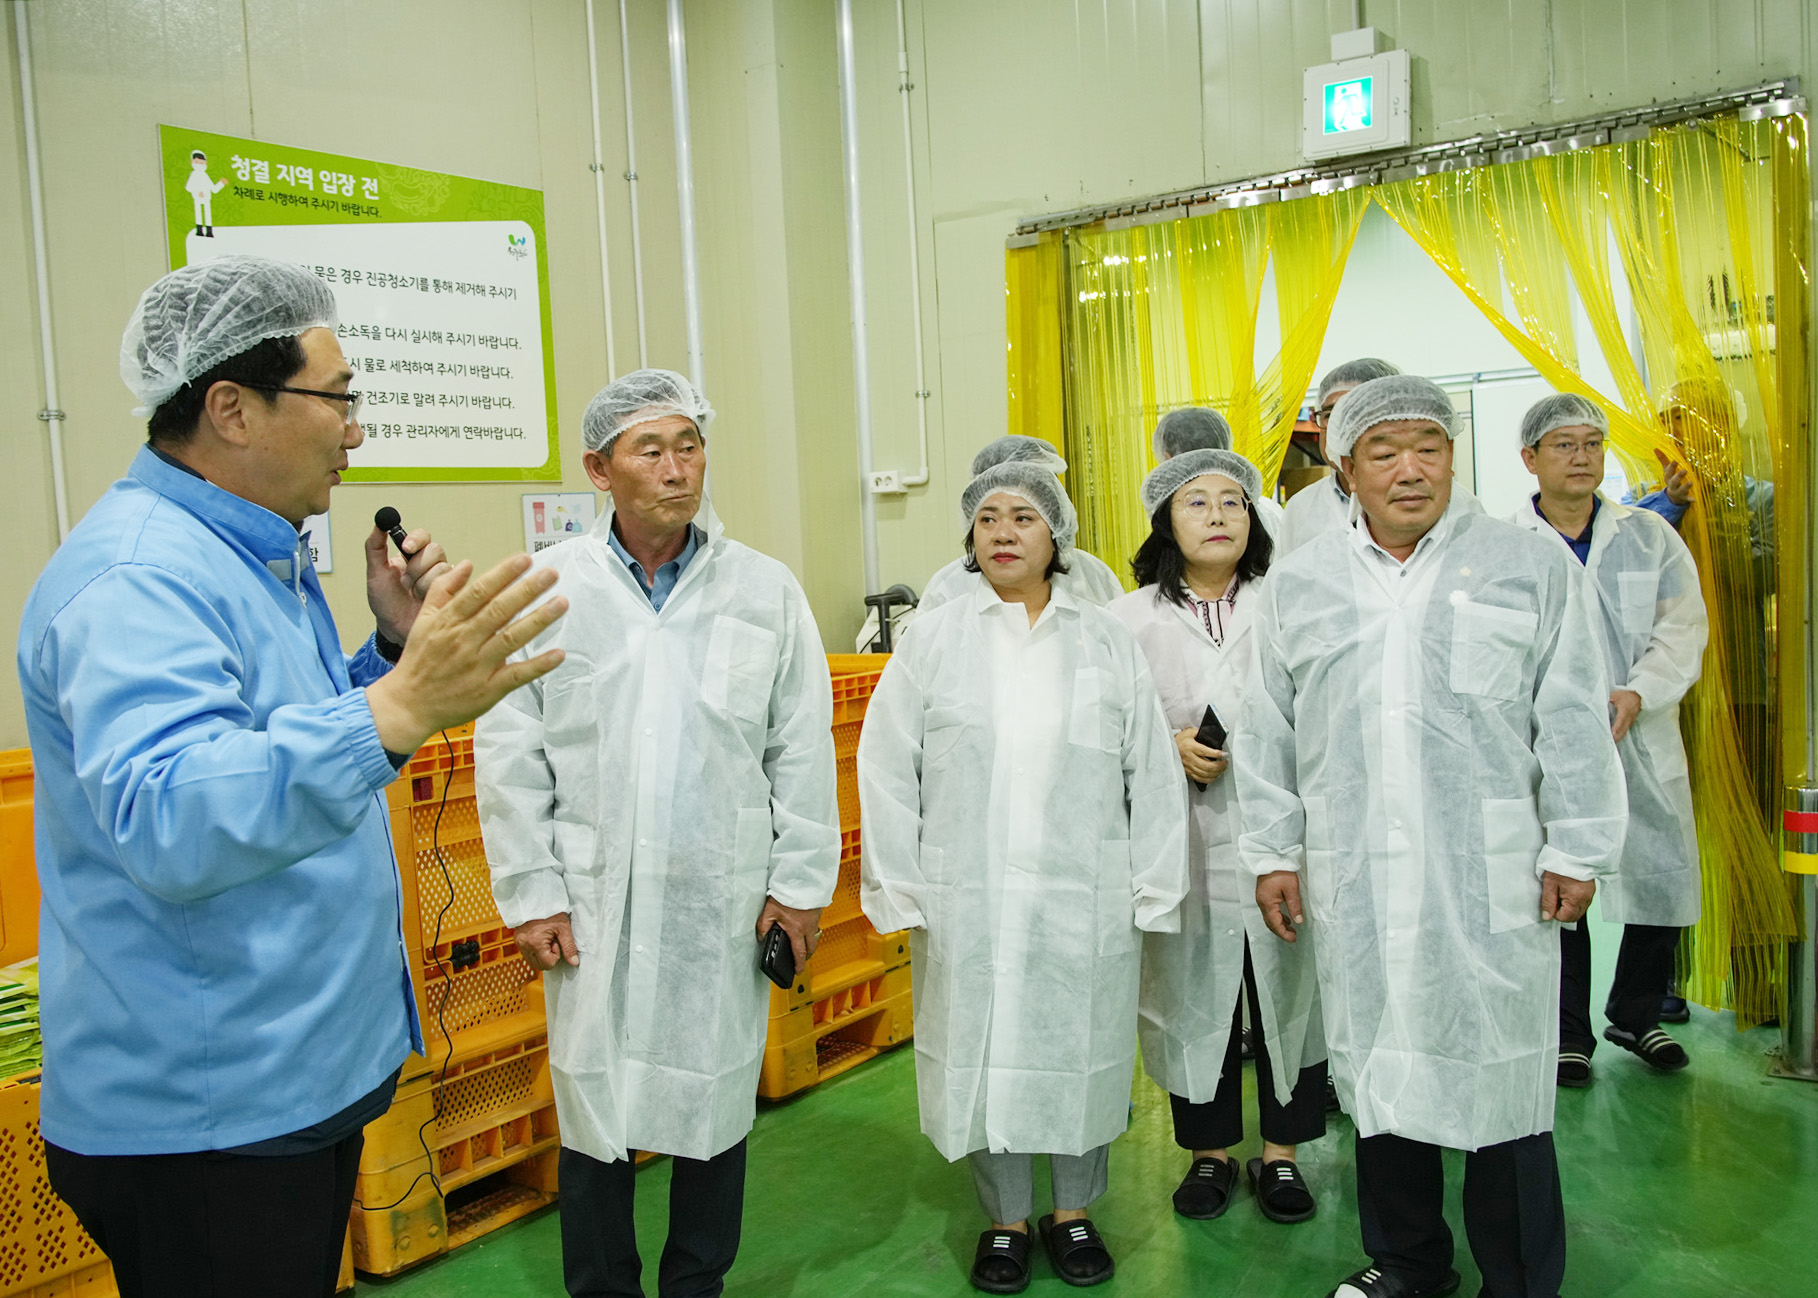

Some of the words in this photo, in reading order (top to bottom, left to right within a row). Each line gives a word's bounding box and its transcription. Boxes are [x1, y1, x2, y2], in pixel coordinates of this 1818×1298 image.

[231, 154, 270, 184] 청결
[276, 164, 314, 191] 지역
[319, 170, 356, 197] 입장
[361, 177, 379, 200] 전
[233, 186, 265, 201] 차례로
[268, 192, 308, 208] 시행하여
[311, 197, 339, 212] 주시기
[342, 203, 382, 218] 바랍니다.
[341, 269, 363, 284] 경우
[366, 271, 430, 293] 진공청소기를
[433, 279, 454, 294] 통해
[455, 281, 486, 297] 제거해
[488, 285, 517, 300] 주시기
[338, 323, 381, 340] 손소독을
[385, 327, 408, 342] 다시
[411, 329, 443, 344] 실시해
[445, 332, 475, 347] 주시기
[478, 335, 522, 350] 바랍니다.
[364, 357, 386, 373] 물로
[390, 360, 434, 375] 세척하여
[436, 362, 467, 377] 주시기
[469, 365, 514, 380] 바랍니다.
[366, 391, 411, 405] 건조기로
[413, 392, 435, 408] 말려
[439, 394, 469, 408] 주시기
[471, 396, 515, 410] 바랍니다.
[381, 423, 403, 438] 경우
[406, 424, 461, 438] 관리자에게
[463, 425, 527, 441] 연락바랍니다.
